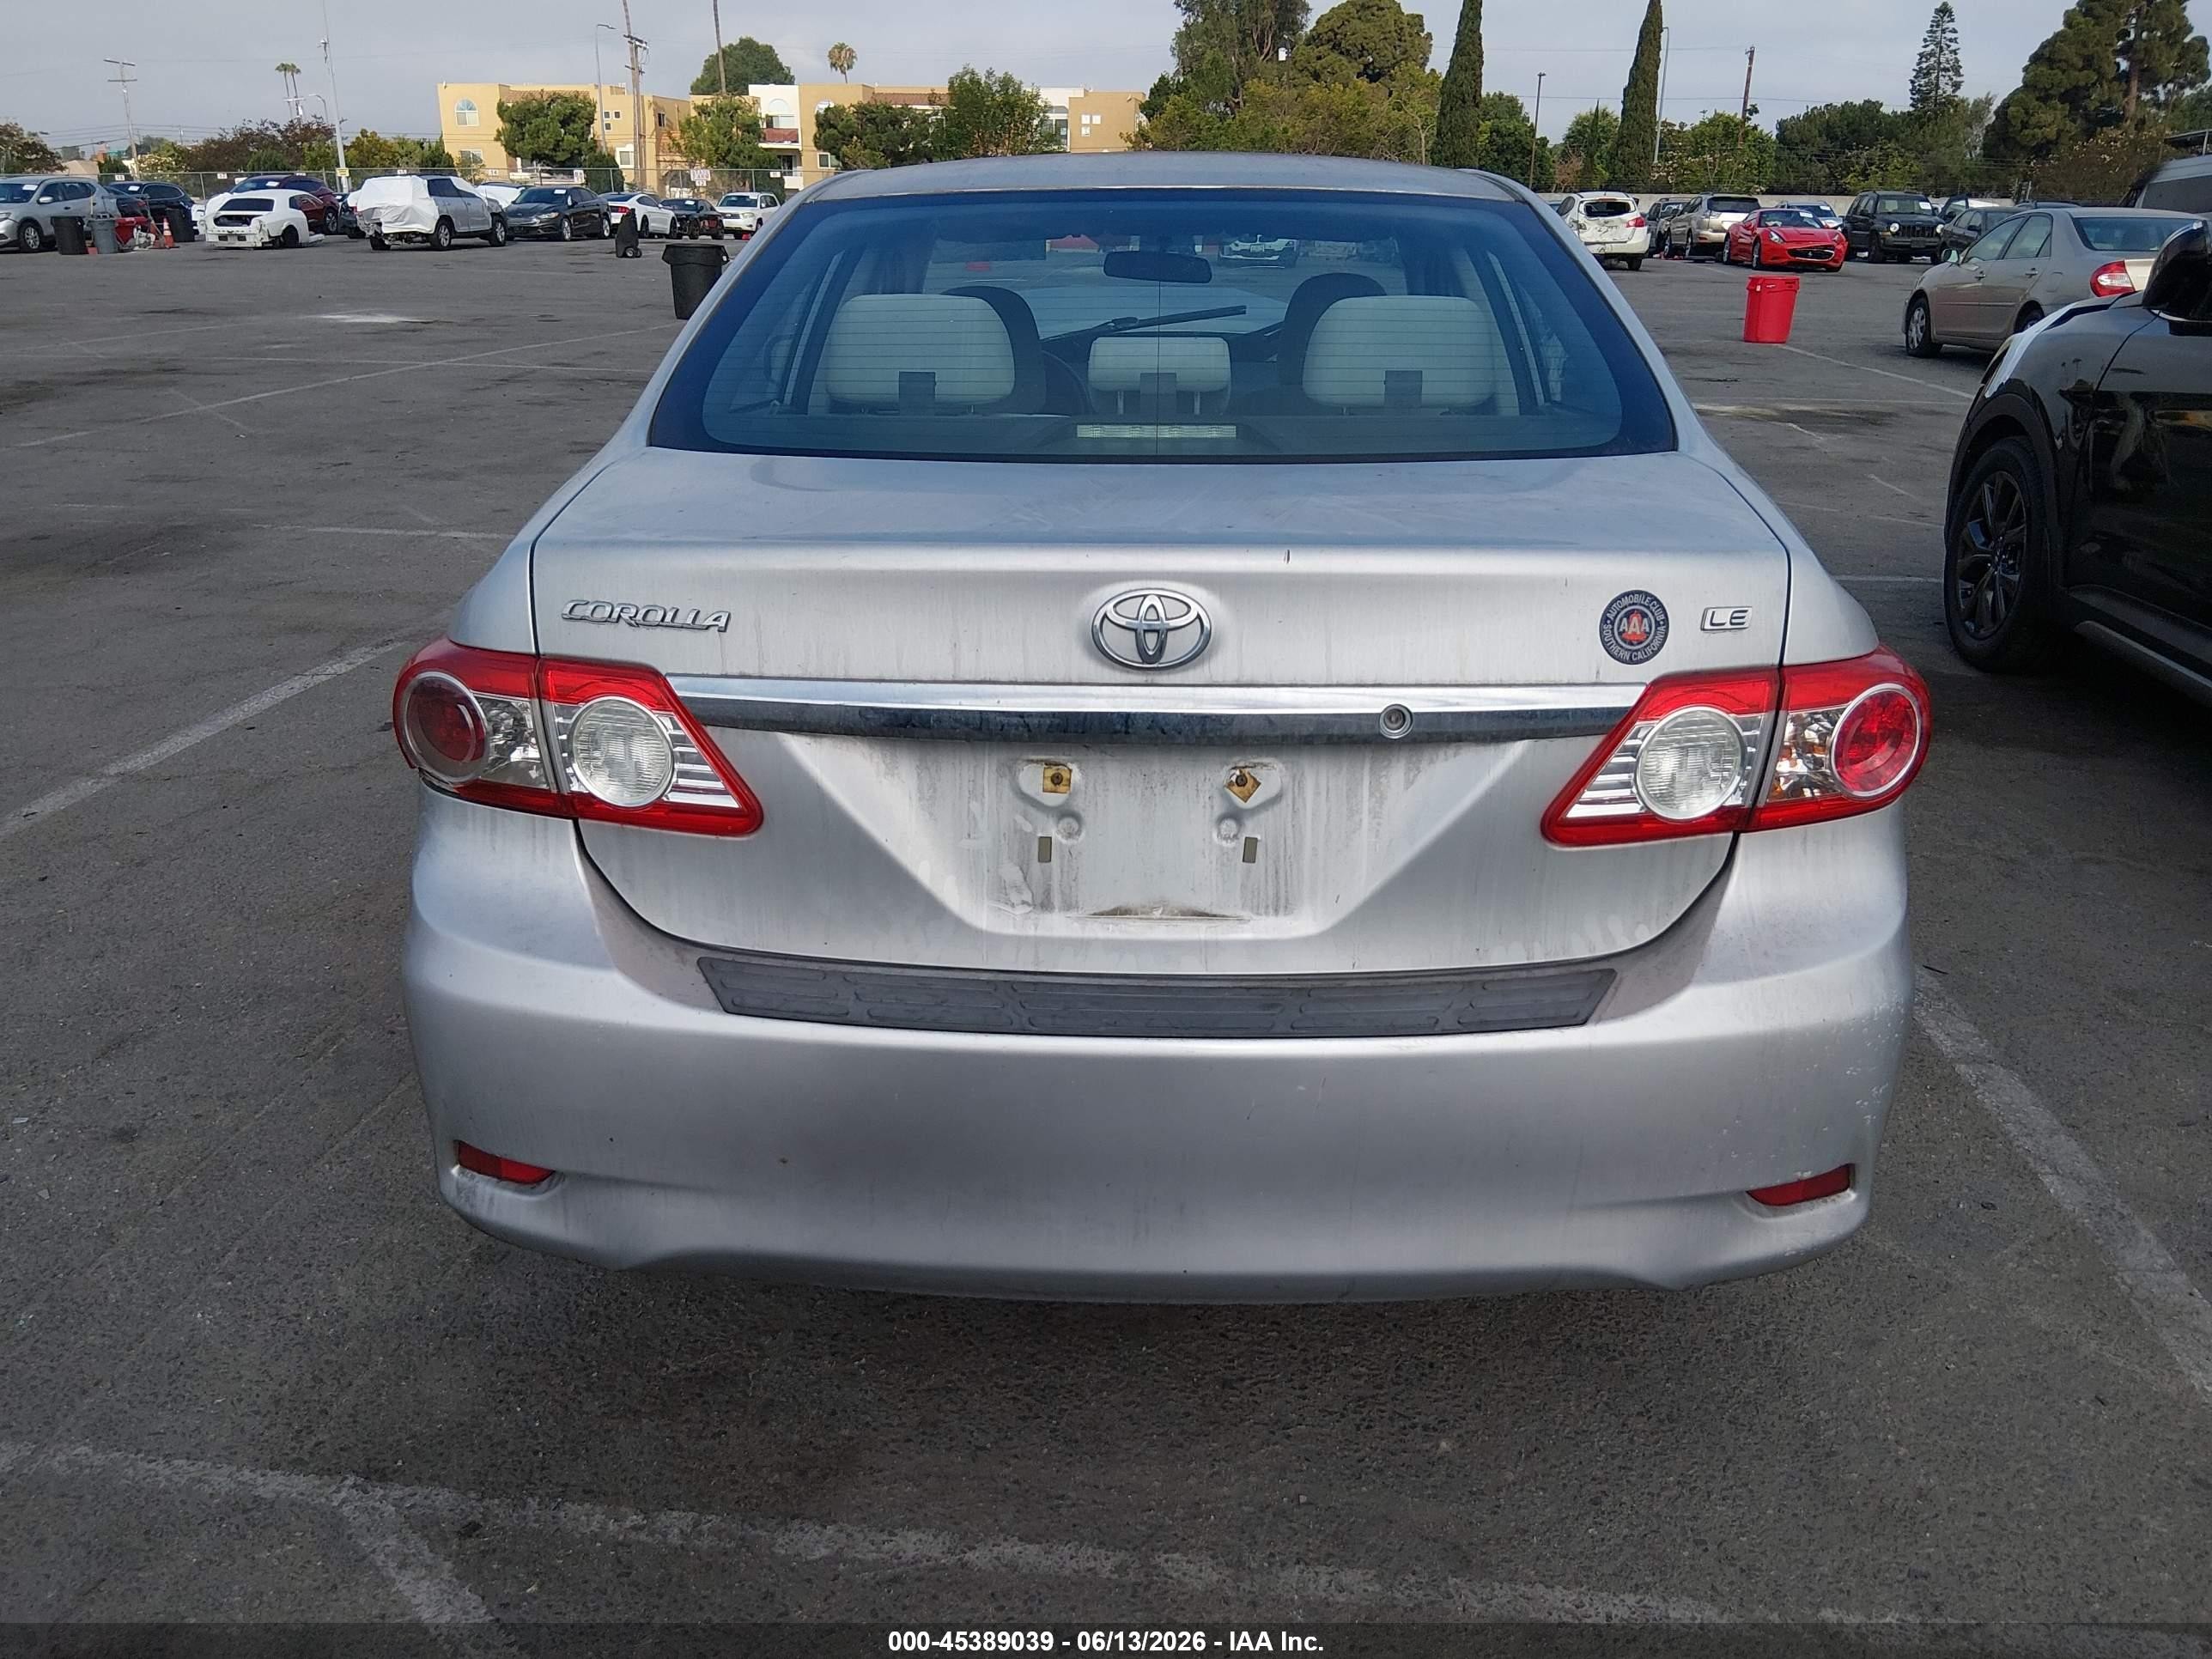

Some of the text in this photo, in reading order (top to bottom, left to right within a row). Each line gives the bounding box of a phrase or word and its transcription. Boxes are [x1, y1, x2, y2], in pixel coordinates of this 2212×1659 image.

[561, 599, 731, 632] COROLLA
[1607, 593, 1665, 622] AUTOMOBILE CLUB
[1709, 609, 1749, 627] LE
[1619, 617, 1650, 635] AAA
[1603, 623, 1667, 660] SOUTHERN CALIFORNIA
